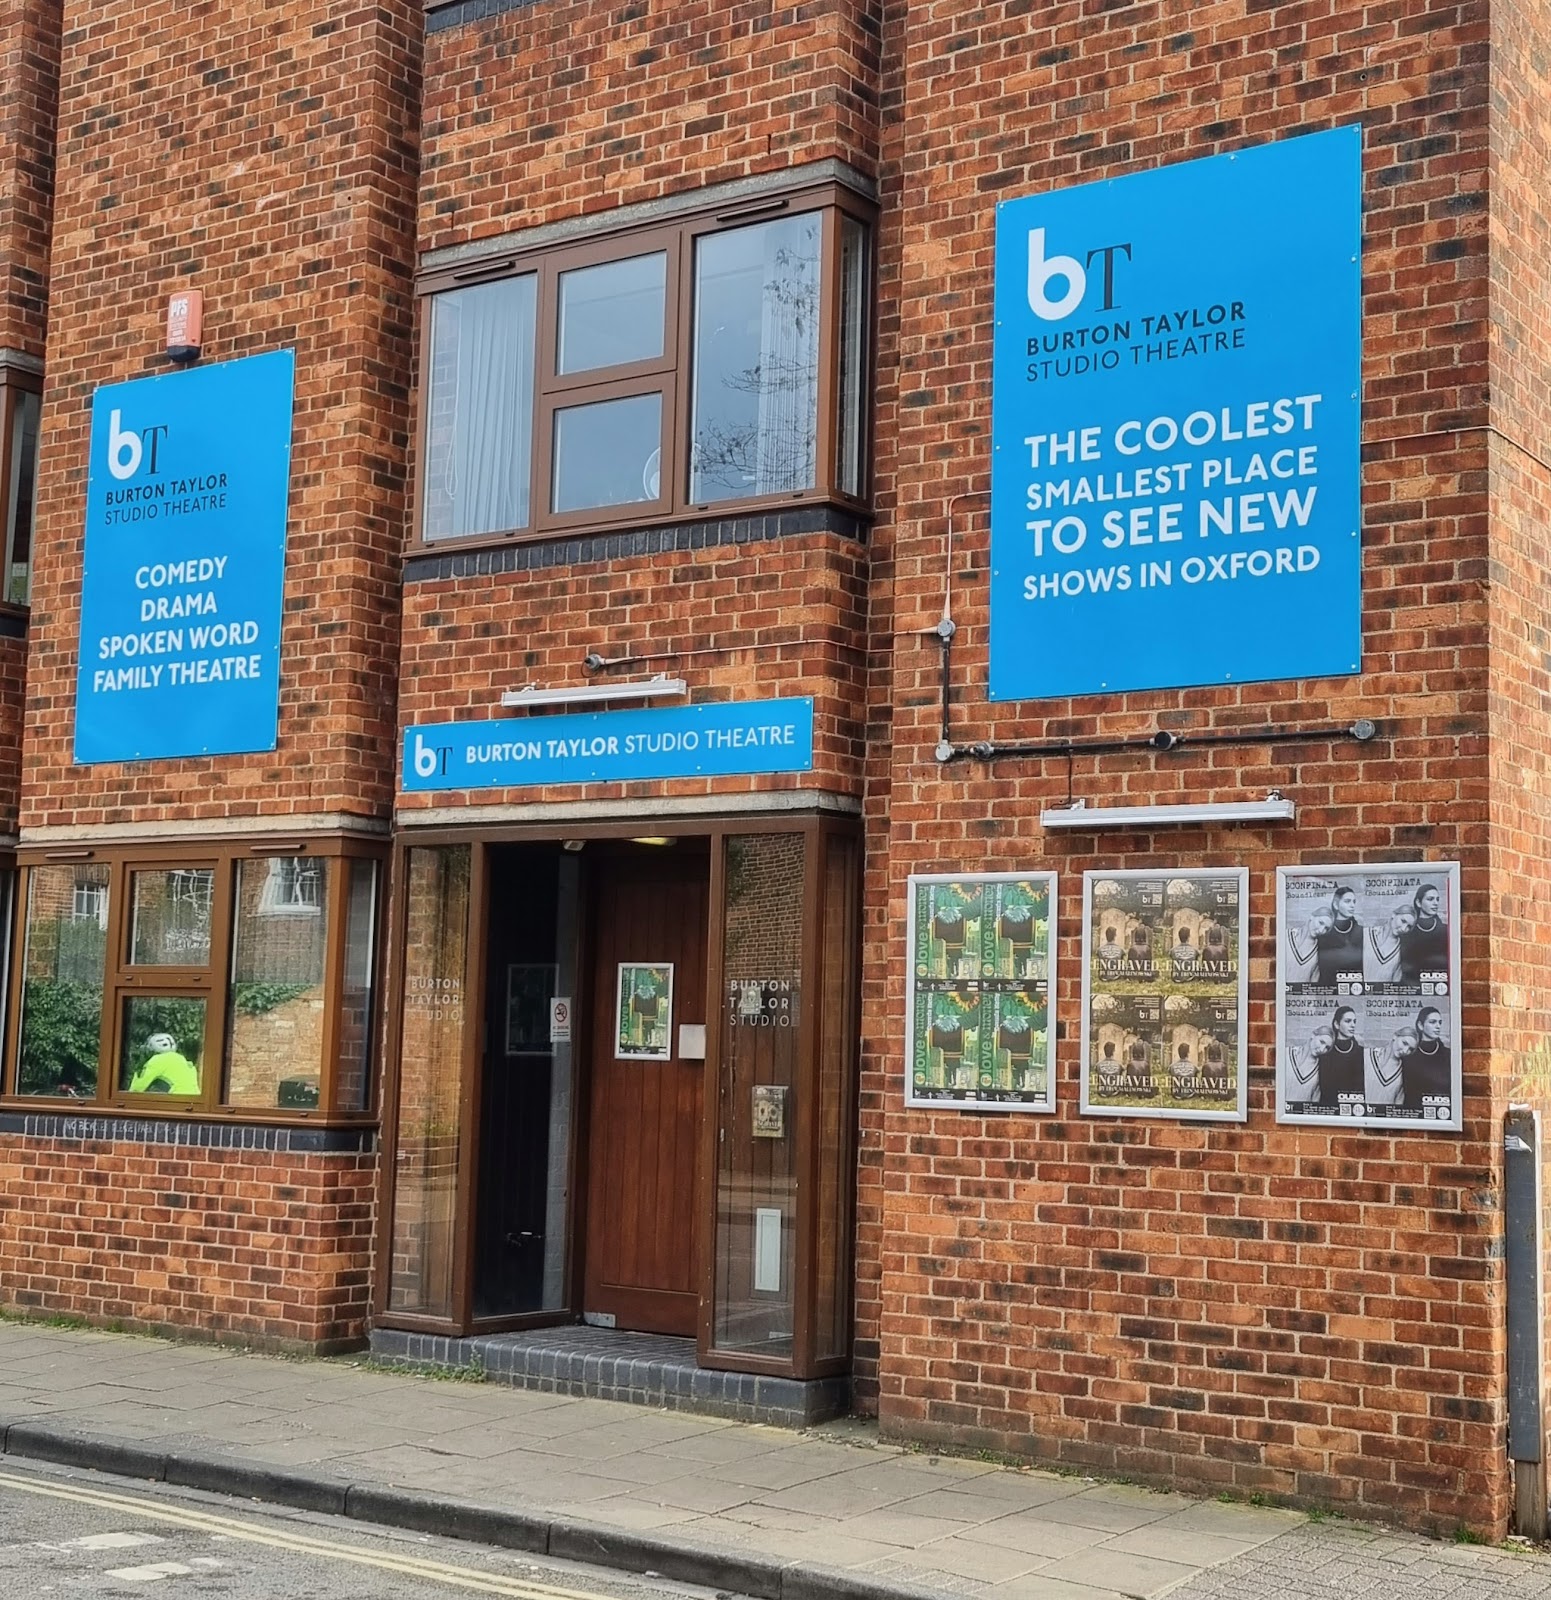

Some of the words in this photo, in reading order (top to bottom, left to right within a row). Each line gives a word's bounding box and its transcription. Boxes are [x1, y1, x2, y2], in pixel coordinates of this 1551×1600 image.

[1027, 227, 1132, 321] bT
[1027, 321, 1131, 356] BURTON
[1141, 301, 1246, 336] TAYLOR
[1026, 350, 1120, 382] STUDIO
[1129, 327, 1246, 365] THEATRE
[108, 409, 168, 480] bT
[1024, 426, 1101, 468] THE
[1114, 393, 1322, 456] COOLEST
[106, 483, 165, 505] BURTON
[170, 473, 228, 496] TAYLOR
[1026, 463, 1192, 511] SMALLEST
[1203, 445, 1318, 488] PLACE
[105, 504, 158, 525] STUDIO
[163, 493, 227, 516] THEATRE
[1026, 515, 1087, 557] TO
[1102, 503, 1183, 549] SEE
[1199, 486, 1318, 538] NEW
[135, 555, 228, 589] COMEDY
[1023, 564, 1132, 600] SHOWS
[1140, 560, 1172, 588] IN
[1181, 544, 1321, 584] OXFORD
[141, 591, 217, 622] DRAMA
[98, 628, 184, 660] SPOKEN
[188, 621, 259, 650] WORD
[93, 664, 164, 693] FAMILY
[168, 654, 262, 686] THEATRE
[414, 734, 453, 778] bT
[466, 741, 541, 764] BURTON
[546, 736, 619, 759] TAYLOR
[625, 731, 699, 754] STUDIO
[704, 725, 795, 749] THEATRE
[916, 932, 928, 964] love
[981, 931, 994, 964] love
[1091, 959, 1160, 972] ENGRAVED
[1165, 959, 1237, 972] ENGRAVED
[410, 994, 459, 1004] TAYLOR
[411, 978, 459, 989] BURTON
[729, 1014, 790, 1027] STUDIO
[914, 1040, 926, 1073] love
[980, 1040, 992, 1074] love
[1091, 1075, 1160, 1088] ENGRAVED
[1165, 1076, 1237, 1090] ENGRAVED
